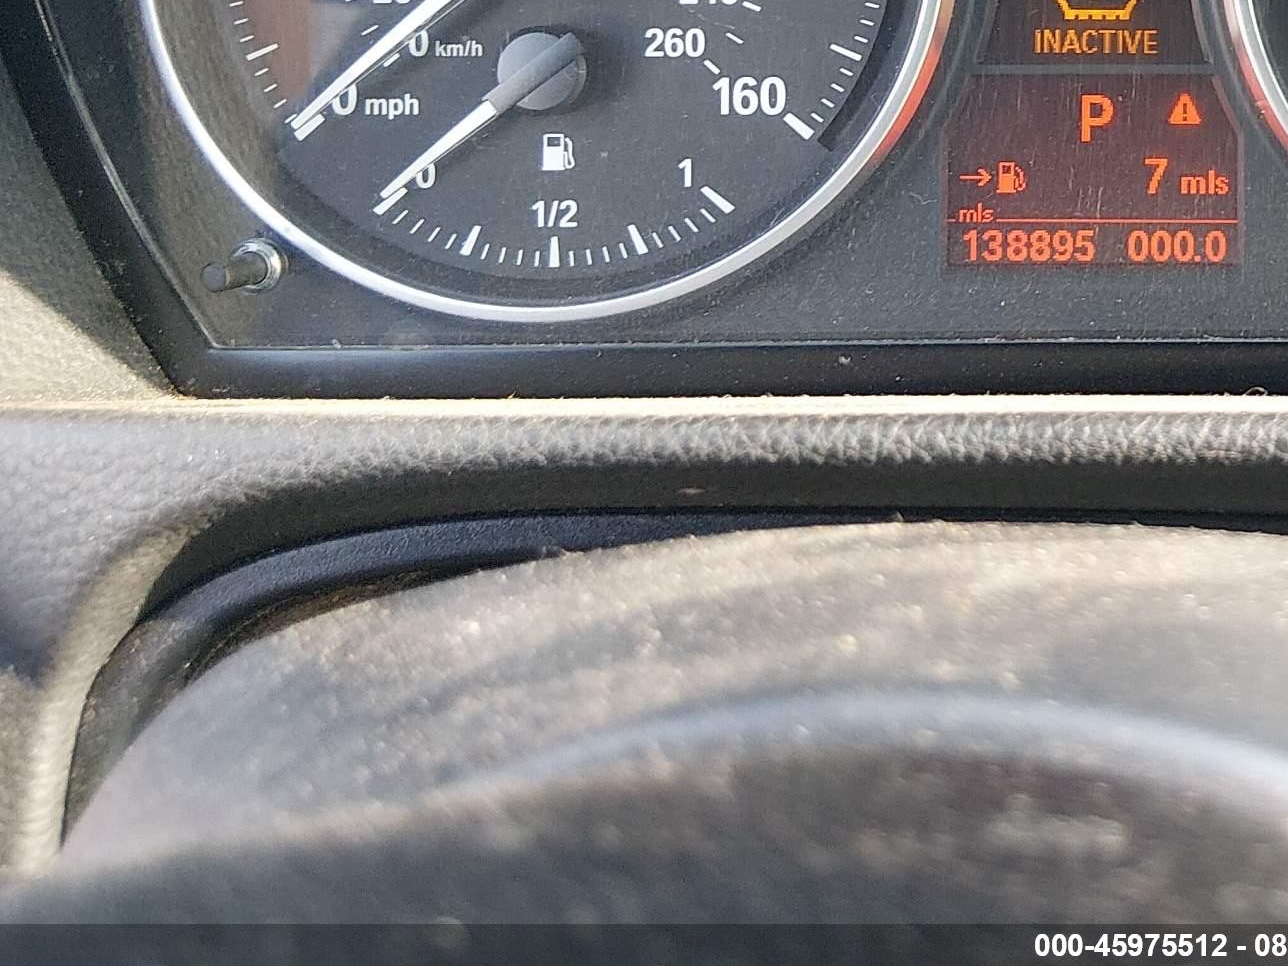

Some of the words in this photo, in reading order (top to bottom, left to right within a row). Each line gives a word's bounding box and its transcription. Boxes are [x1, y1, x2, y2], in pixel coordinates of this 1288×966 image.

[408, 30, 429, 56] 0
[435, 40, 483, 57] km/h
[645, 28, 705, 58] 260
[1033, 29, 1159, 54] INACTIVE
[332, 84, 357, 116] 0
[365, 94, 420, 120] mph
[712, 76, 786, 116] 160
[1079, 95, 1114, 143] P
[416, 163, 436, 188] 0
[678, 158, 693, 187] 1
[1144, 158, 1169, 195] 7
[1180, 170, 1230, 196] mls
[531, 199, 579, 228] 1/2
[959, 203, 995, 222] mls
[962, 229, 1096, 262] 138895
[1126, 229, 1227, 262] 000.0
